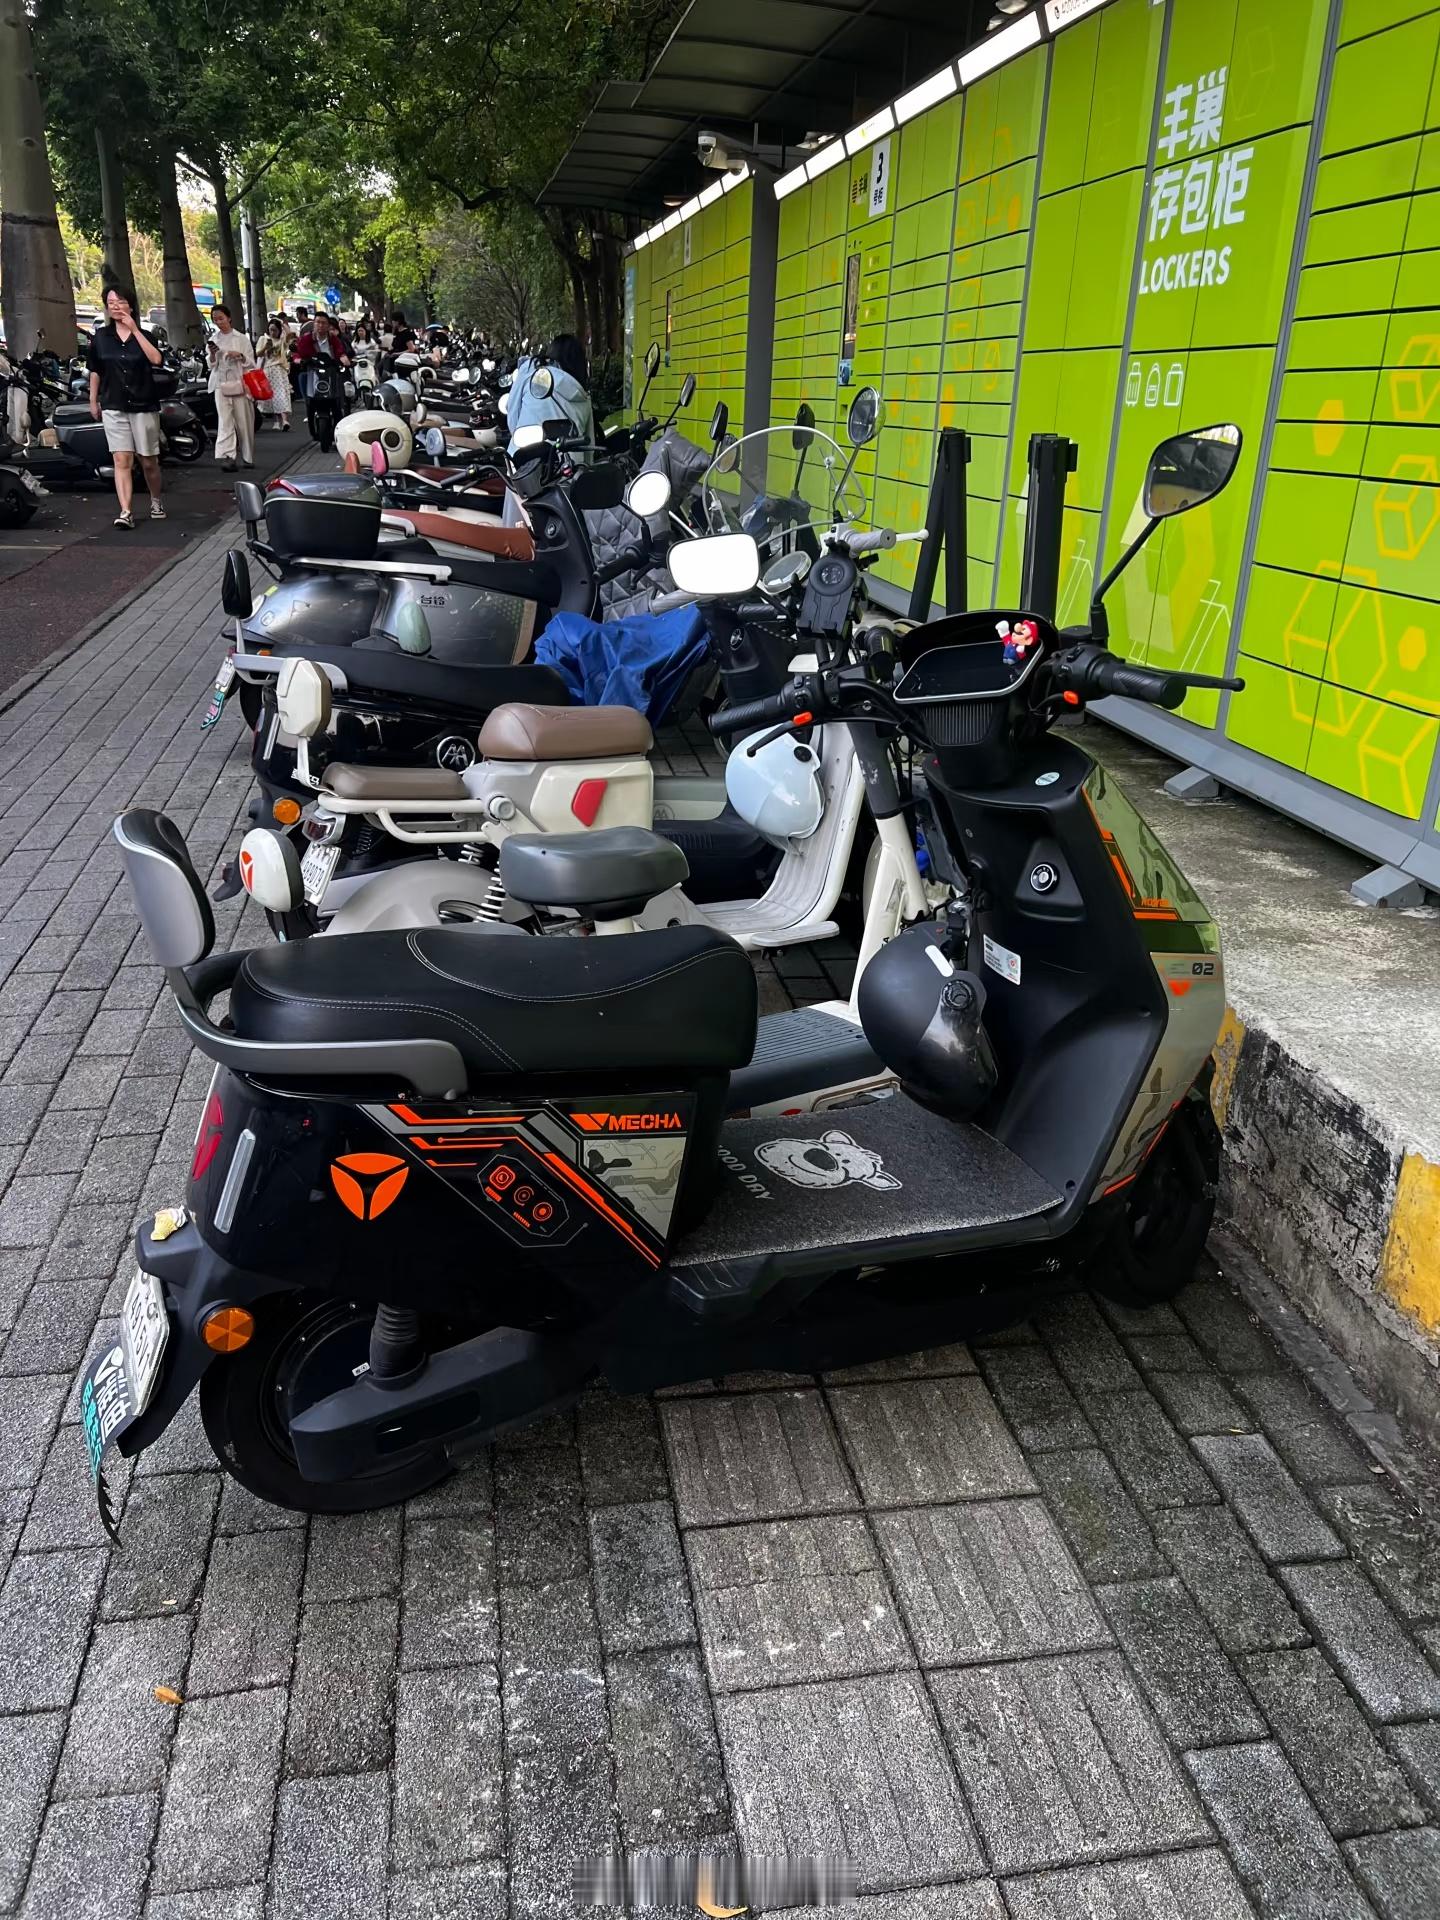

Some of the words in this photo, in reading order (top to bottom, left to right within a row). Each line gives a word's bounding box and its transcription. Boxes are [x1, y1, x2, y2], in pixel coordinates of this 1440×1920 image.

[1158, 66, 1228, 159] 丰巢
[1148, 147, 1254, 242] 存包柜
[1138, 246, 1232, 295] LOCKERS
[1192, 962, 1215, 976] 02
[608, 1112, 682, 1131] MECHA
[716, 1144, 747, 1171] OOD
